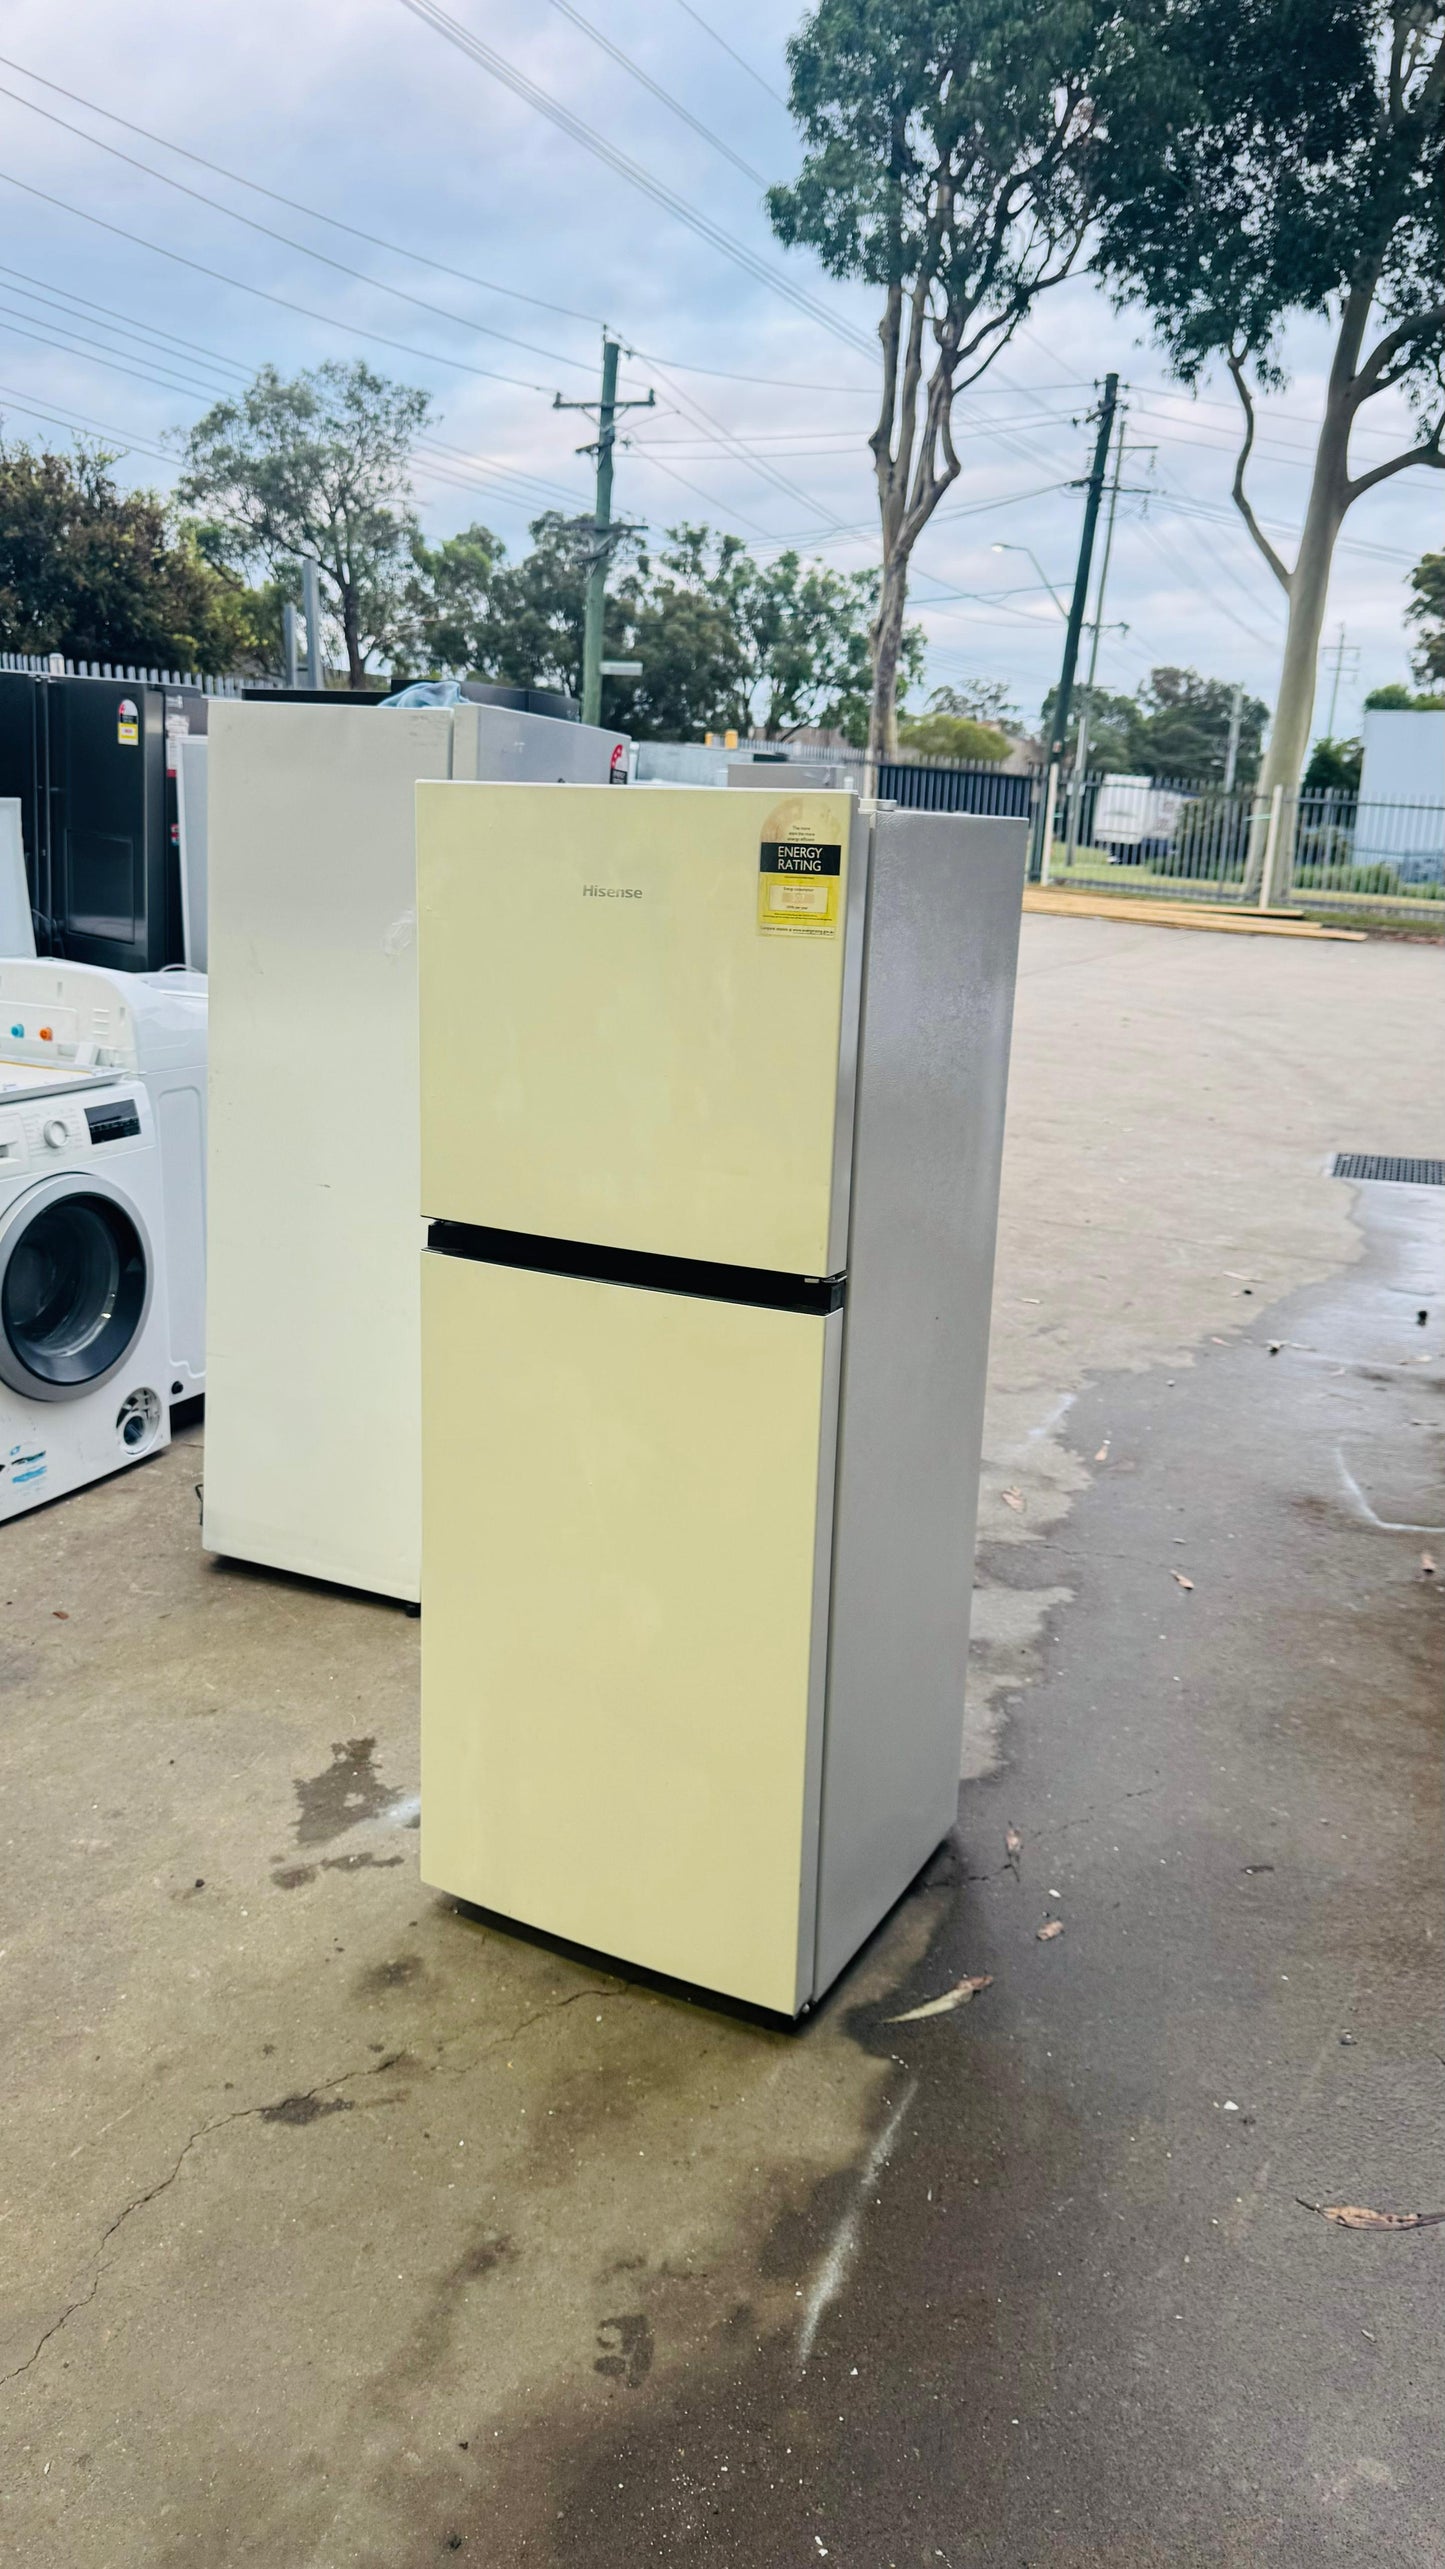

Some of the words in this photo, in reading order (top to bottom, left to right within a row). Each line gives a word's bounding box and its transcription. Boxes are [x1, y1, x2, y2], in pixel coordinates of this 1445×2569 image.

[778, 846, 823, 859] ENERGY
[778, 859, 822, 871] RATING
[582, 884, 643, 899] Hisense
